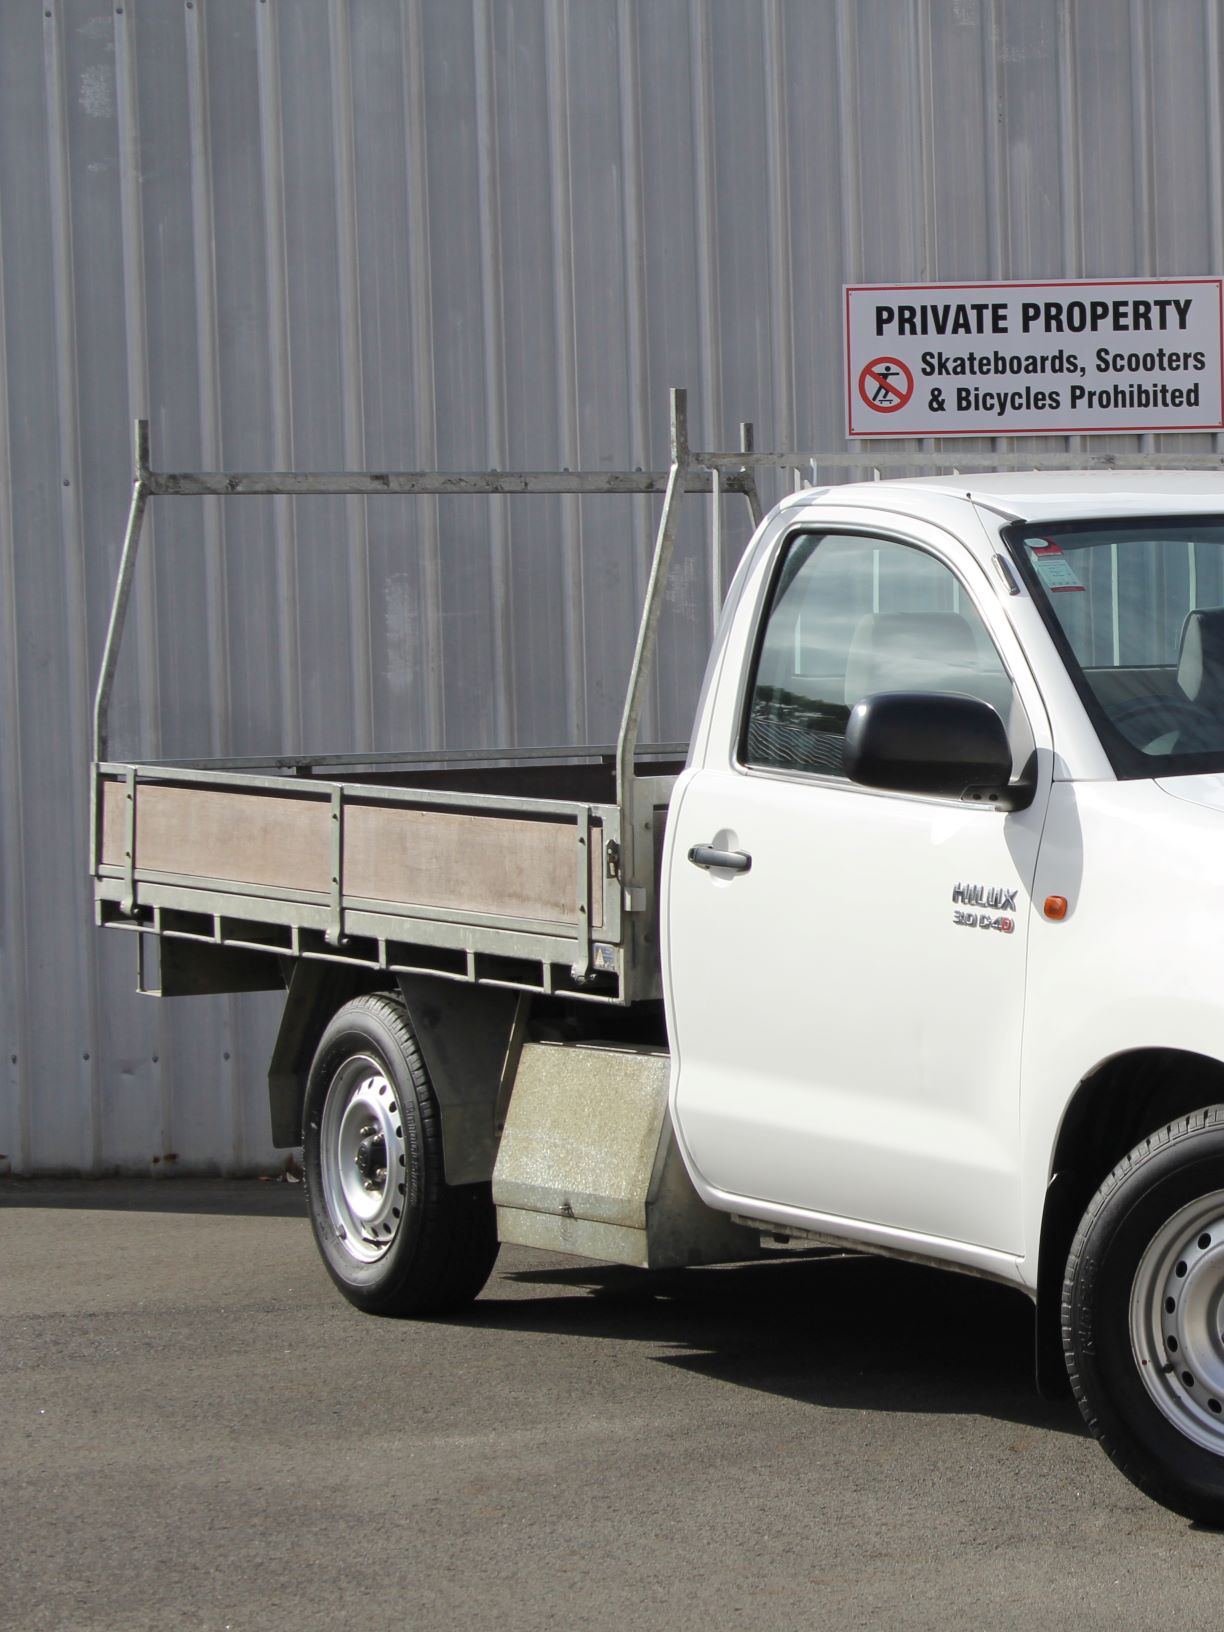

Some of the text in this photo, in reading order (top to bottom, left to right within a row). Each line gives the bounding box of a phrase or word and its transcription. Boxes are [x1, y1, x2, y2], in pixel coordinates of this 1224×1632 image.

[875, 299, 1193, 336] PRIVATE PROPERTY
[920, 347, 1206, 378] Skateboards, Scooters
[928, 382, 1200, 416] & Bicycles Prohibited
[952, 882, 1018, 912] HILUX
